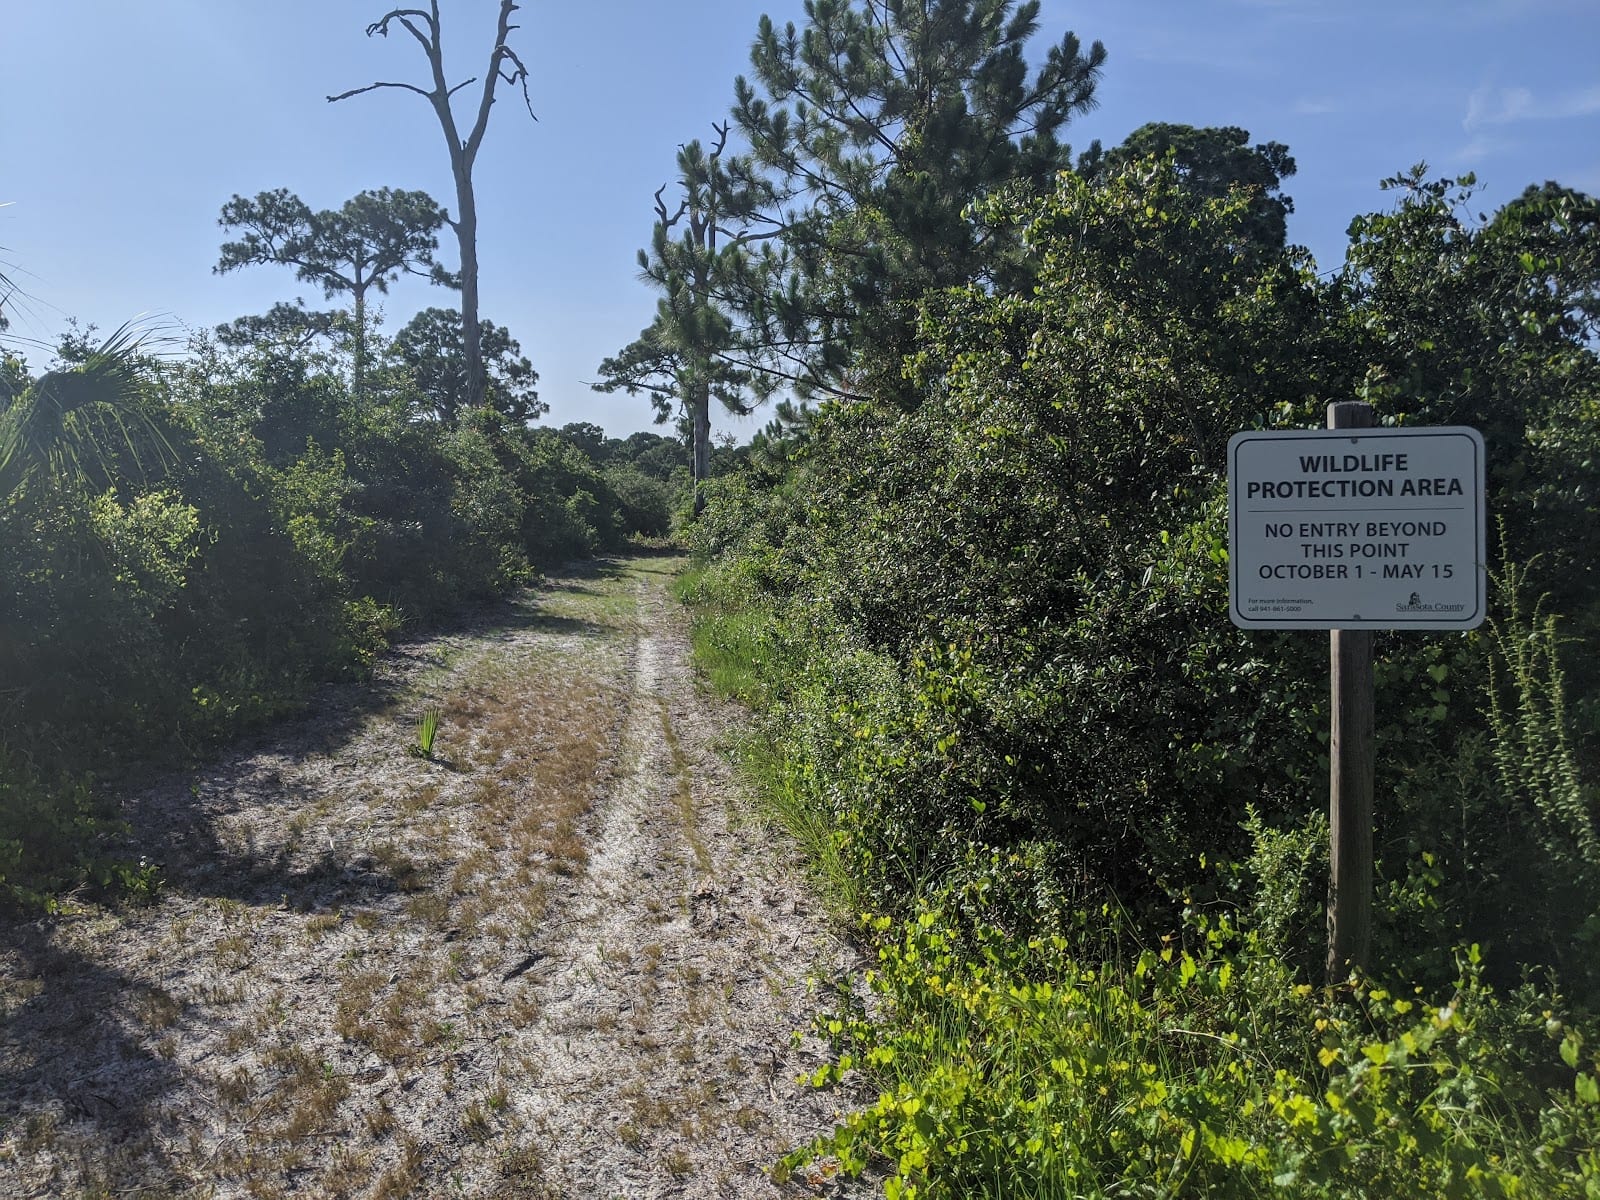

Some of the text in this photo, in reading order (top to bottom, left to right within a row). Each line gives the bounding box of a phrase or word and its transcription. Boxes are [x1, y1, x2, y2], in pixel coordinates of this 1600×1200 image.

[1299, 453, 1409, 473] WILDLIFE
[1247, 478, 1464, 499] PROTECTION AREA
[1265, 521, 1447, 538] NO ENTRY BEYOND
[1301, 543, 1409, 559] THIS POINT
[1258, 564, 1348, 579] OCTOBER
[1354, 564, 1362, 579] 1
[1383, 564, 1425, 579] MAY
[1432, 563, 1454, 579] 15
[1434, 602, 1465, 612] County
